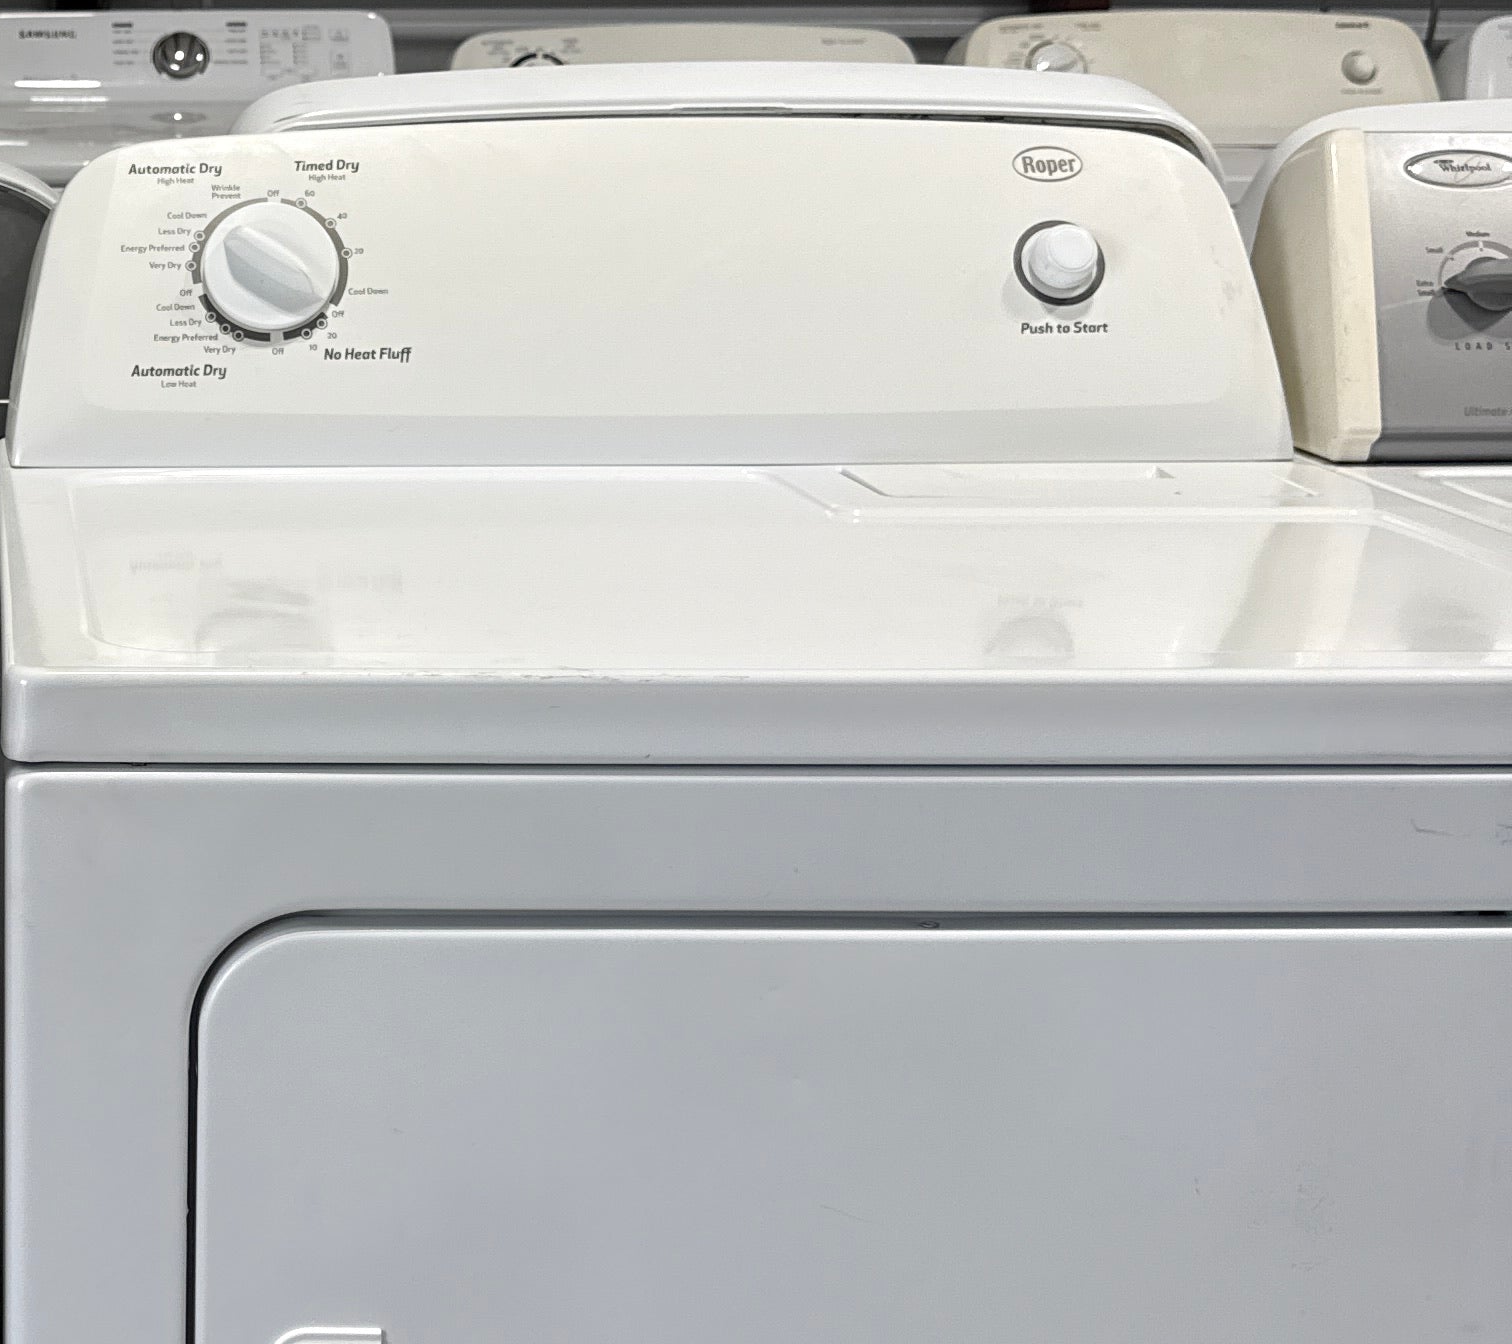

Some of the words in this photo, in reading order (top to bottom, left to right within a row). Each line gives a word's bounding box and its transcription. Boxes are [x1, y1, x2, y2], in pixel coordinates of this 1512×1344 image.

[128, 163, 196, 175] Automatic
[199, 163, 223, 177] Dry
[294, 160, 334, 172] Timed
[337, 159, 359, 173] Dry
[1021, 155, 1076, 176] Roper
[1439, 161, 1491, 174] Whirlpool
[157, 177, 174, 186] High
[308, 174, 325, 182] High
[211, 184, 240, 192] Wrinkle
[211, 192, 241, 200] Prevent
[267, 189, 280, 197] Off
[167, 212, 186, 220] Cool
[337, 212, 348, 220] 40
[177, 227, 191, 236] Dry
[120, 244, 147, 254] Energy
[148, 244, 185, 253] Preferred
[354, 247, 364, 255] 20
[149, 261, 166, 271] Very
[168, 261, 182, 271] Dry
[180, 289, 192, 297] Off
[348, 287, 365, 296] Cool
[367, 287, 388, 295] Down
[156, 303, 174, 311] Cool
[175, 303, 195, 311] Down
[331, 310, 345, 318] Off
[188, 319, 202, 328] Dry
[1021, 322, 1053, 334] Push
[1057, 323, 1070, 333] to
[1073, 321, 1108, 333] Start
[154, 334, 180, 344] Energy
[182, 334, 218, 342] Preferred
[204, 346, 220, 355] Very
[222, 346, 236, 355] Dry
[324, 348, 341, 361] No
[344, 348, 376, 360] Heat
[379, 347, 412, 363] Fluff
[131, 365, 200, 377] Automatic
[203, 364, 227, 379] Dry
[178, 380, 197, 388] Heat
